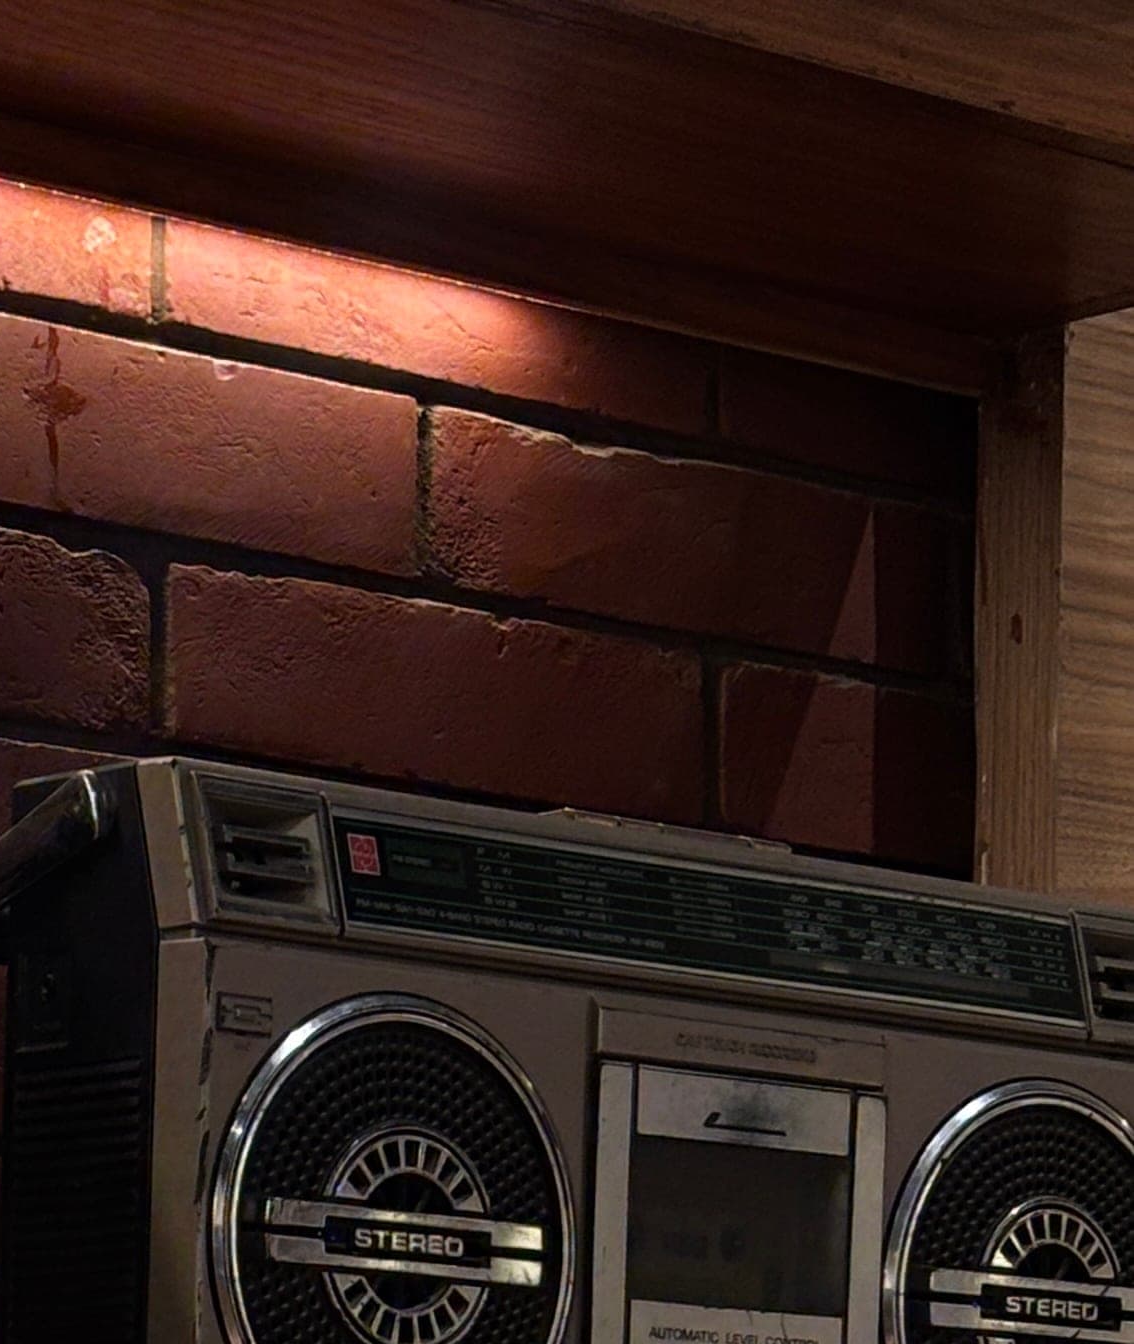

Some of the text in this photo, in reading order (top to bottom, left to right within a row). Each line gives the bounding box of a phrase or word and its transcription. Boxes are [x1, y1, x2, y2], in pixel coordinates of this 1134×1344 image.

[353, 1228, 464, 1258] STEREO
[1004, 1295, 1099, 1322] STEREO
[649, 1326, 719, 1344] AUTOMATIC
